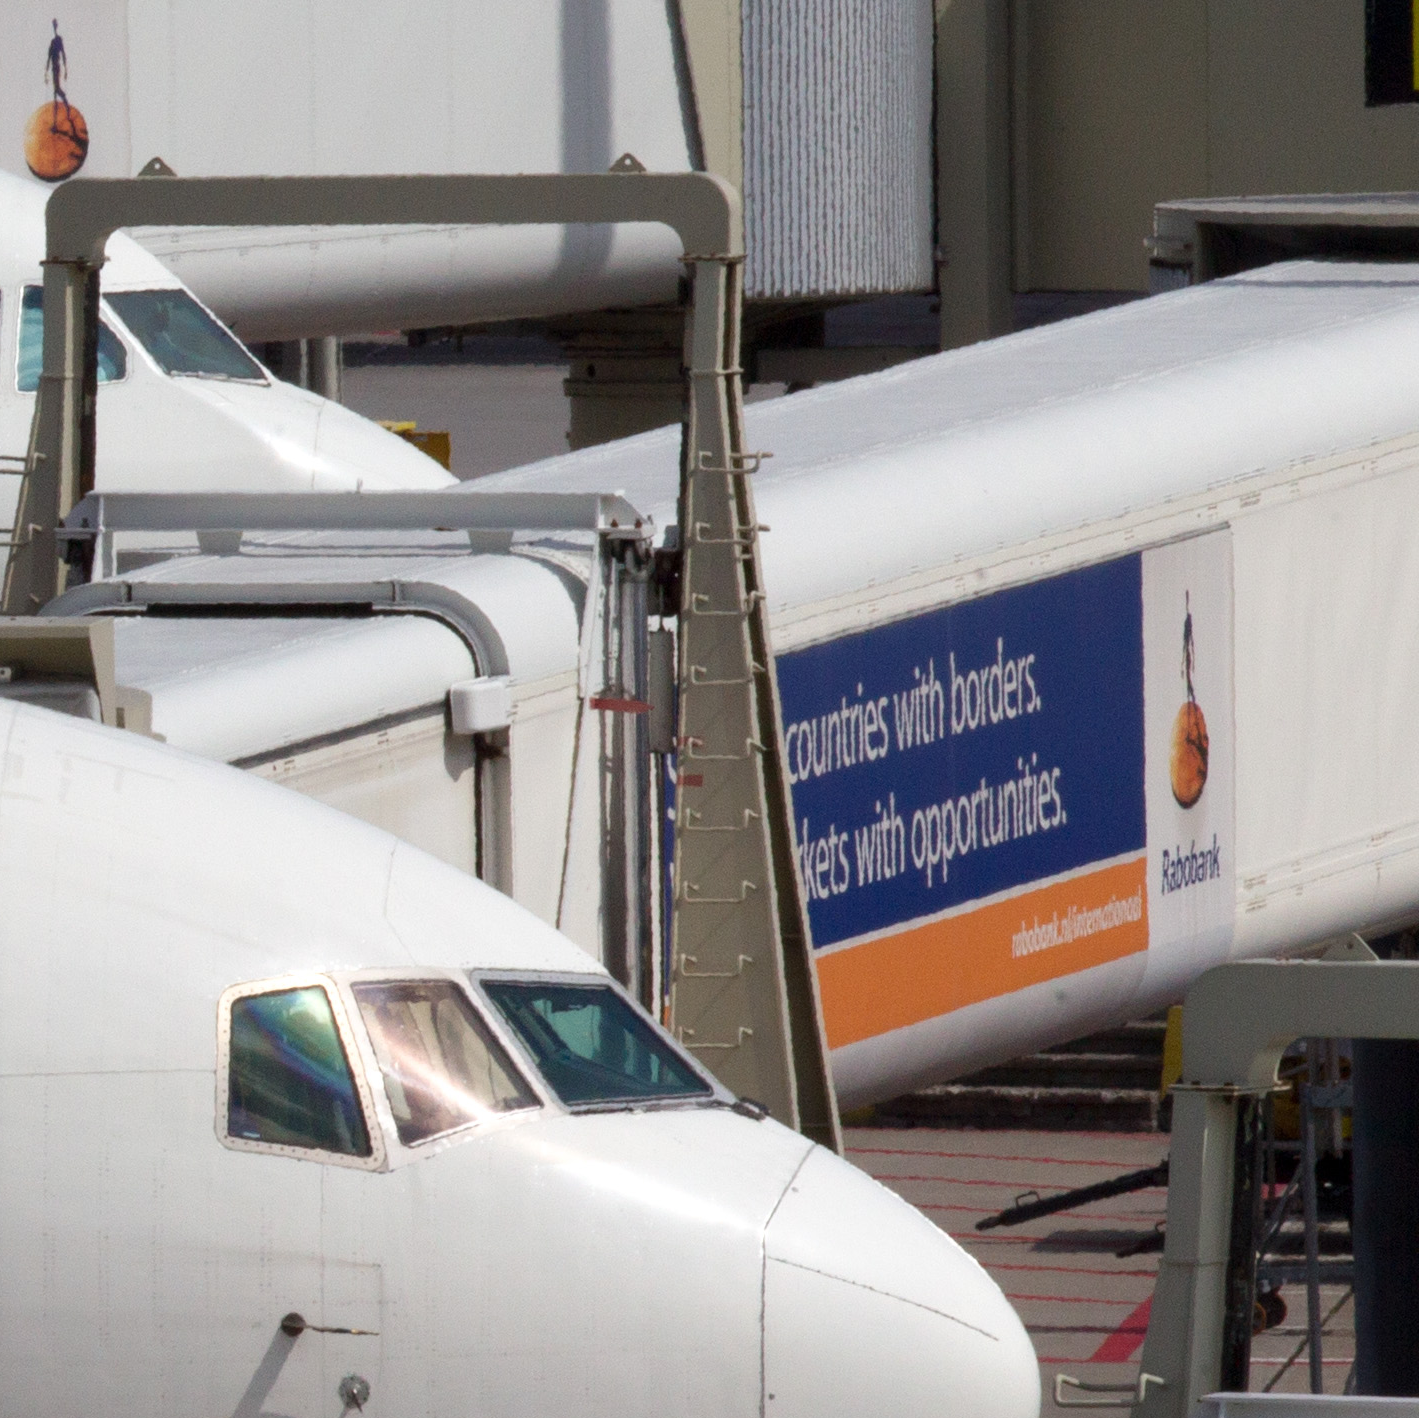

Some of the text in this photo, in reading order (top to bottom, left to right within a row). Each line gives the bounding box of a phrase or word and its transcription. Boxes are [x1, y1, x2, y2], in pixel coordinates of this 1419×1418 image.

[785, 636, 1042, 785] countries with borders.
[854, 792, 906, 887] with
[911, 752, 1068, 889] opportunities.
[1161, 833, 1221, 896] Rabobank
